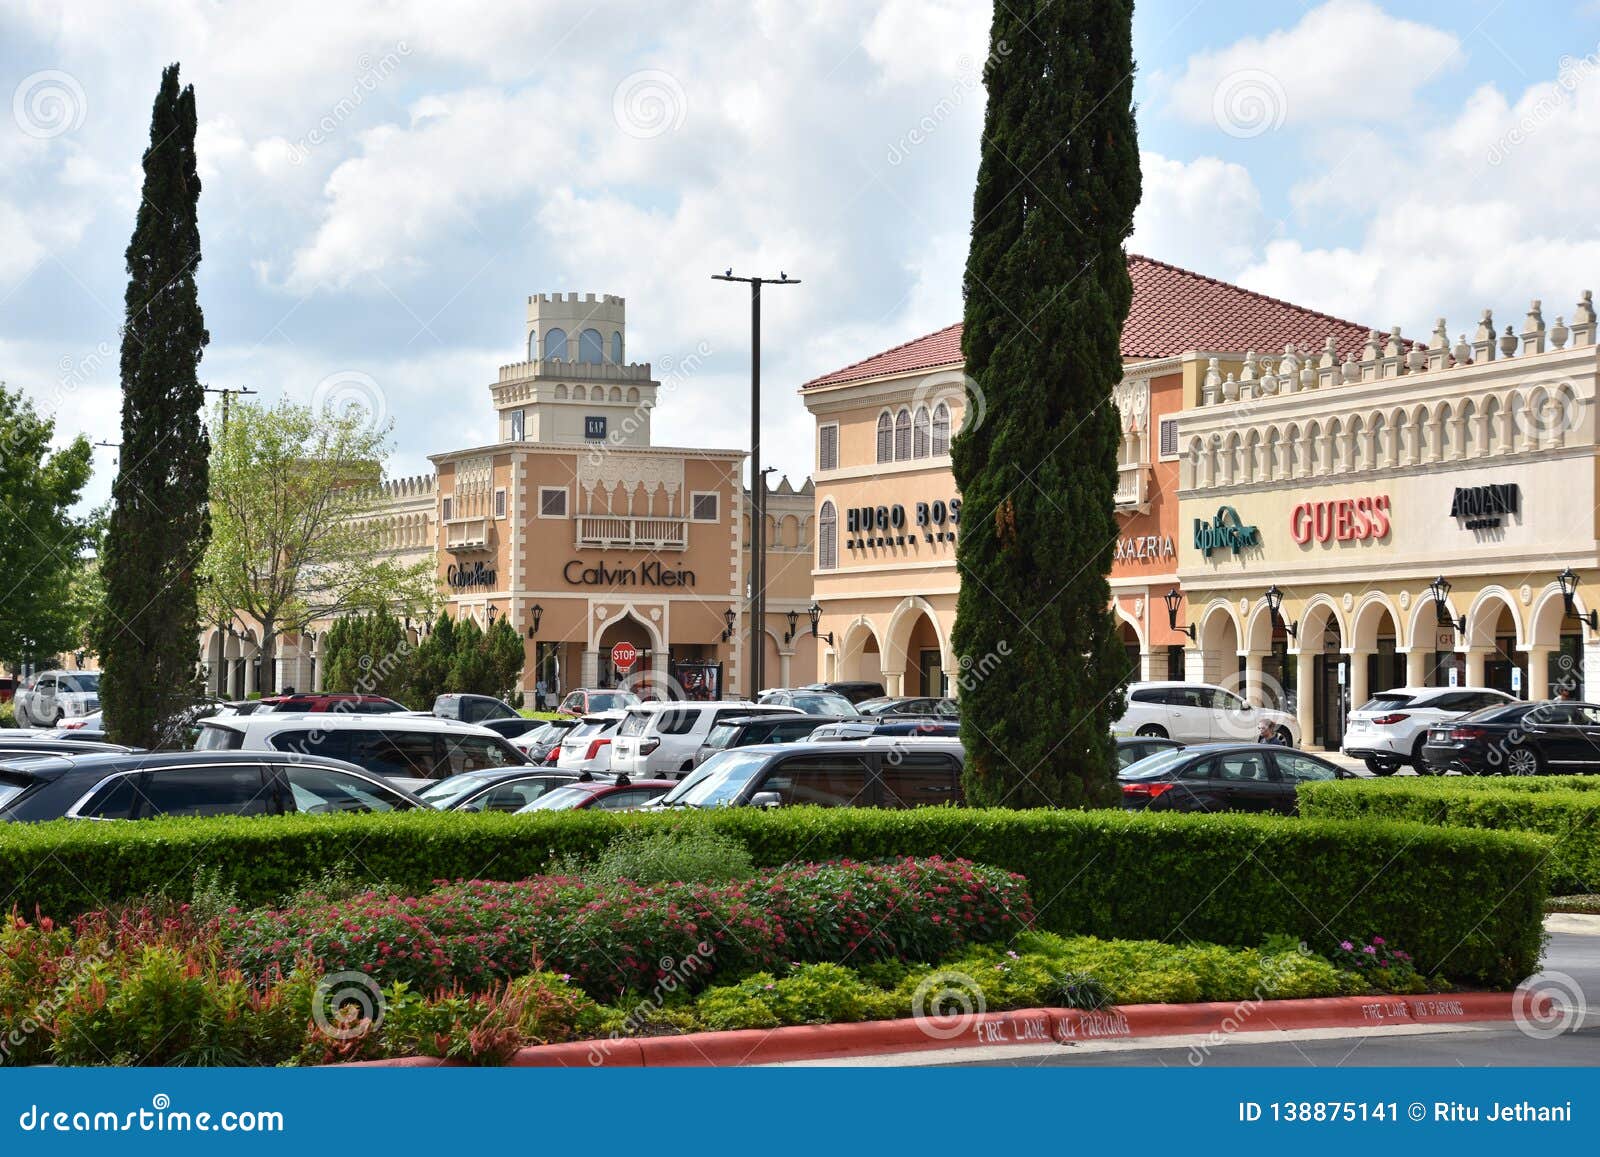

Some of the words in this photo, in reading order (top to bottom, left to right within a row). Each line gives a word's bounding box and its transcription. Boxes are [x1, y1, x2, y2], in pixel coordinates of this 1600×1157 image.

[588, 421, 604, 433] GAP
[1449, 483, 1518, 517] ARMANI
[847, 504, 905, 532] HUGO
[916, 498, 961, 526] BOS
[1290, 494, 1391, 545] GUESS
[1113, 535, 1173, 559] XAZRIA
[563, 560, 636, 586] Calvin
[641, 561, 696, 587] Klein
[613, 650, 635, 660] STOP
[1362, 1004, 1384, 1019] FIRE
[1385, 1002, 1408, 1017] LANE
[1415, 1000, 1427, 1016] NO
[1429, 1000, 1463, 1016] PARKING
[976, 1020, 1008, 1042] FIRE
[1013, 1018, 1049, 1040] LANE
[1058, 1017, 1076, 1038] NO
[1080, 1014, 1131, 1037] PARKING
